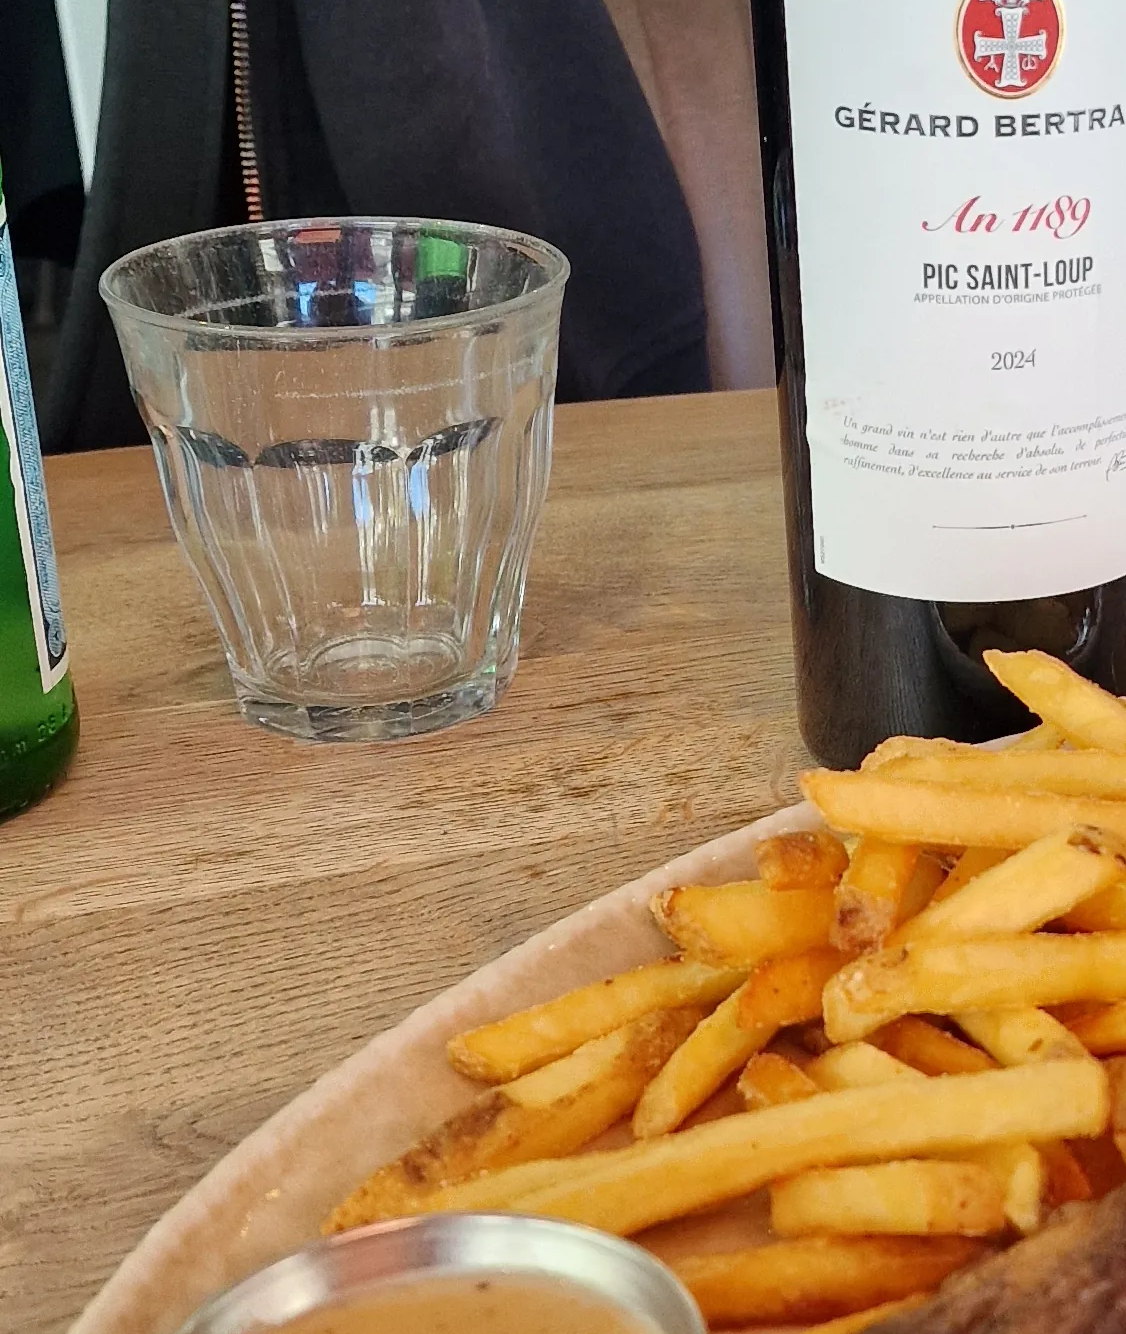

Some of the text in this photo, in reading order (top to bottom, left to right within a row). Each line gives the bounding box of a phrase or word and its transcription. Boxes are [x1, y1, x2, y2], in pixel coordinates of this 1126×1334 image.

[834, 102, 980, 139] GÉRARD
[921, 194, 1092, 240] An 1189
[922, 255, 1094, 291] PIC SAINT-LOUP
[913, 283, 1103, 305] APPELLATION D'ORIGINE PROTÉGÉE
[990, 348, 1037, 371] 2024
[843, 416, 858, 430] Un
[862, 423, 893, 436] grand
[897, 427, 914, 439] vin
[920, 429, 947, 442] n'est
[952, 430, 975, 442] rien
[980, 429, 1022, 443] d'autre
[1026, 430, 1047, 443] que
[888, 443, 915, 457] dans
[925, 451, 939, 460] sa
[951, 448, 1005, 462] recherche
[1075, 439, 1086, 452] de
[908, 464, 974, 480] d'excellence
[977, 471, 993, 480] au
[995, 467, 1033, 479] service
[1035, 464, 1047, 476] de
[1049, 463, 1068, 474] son
